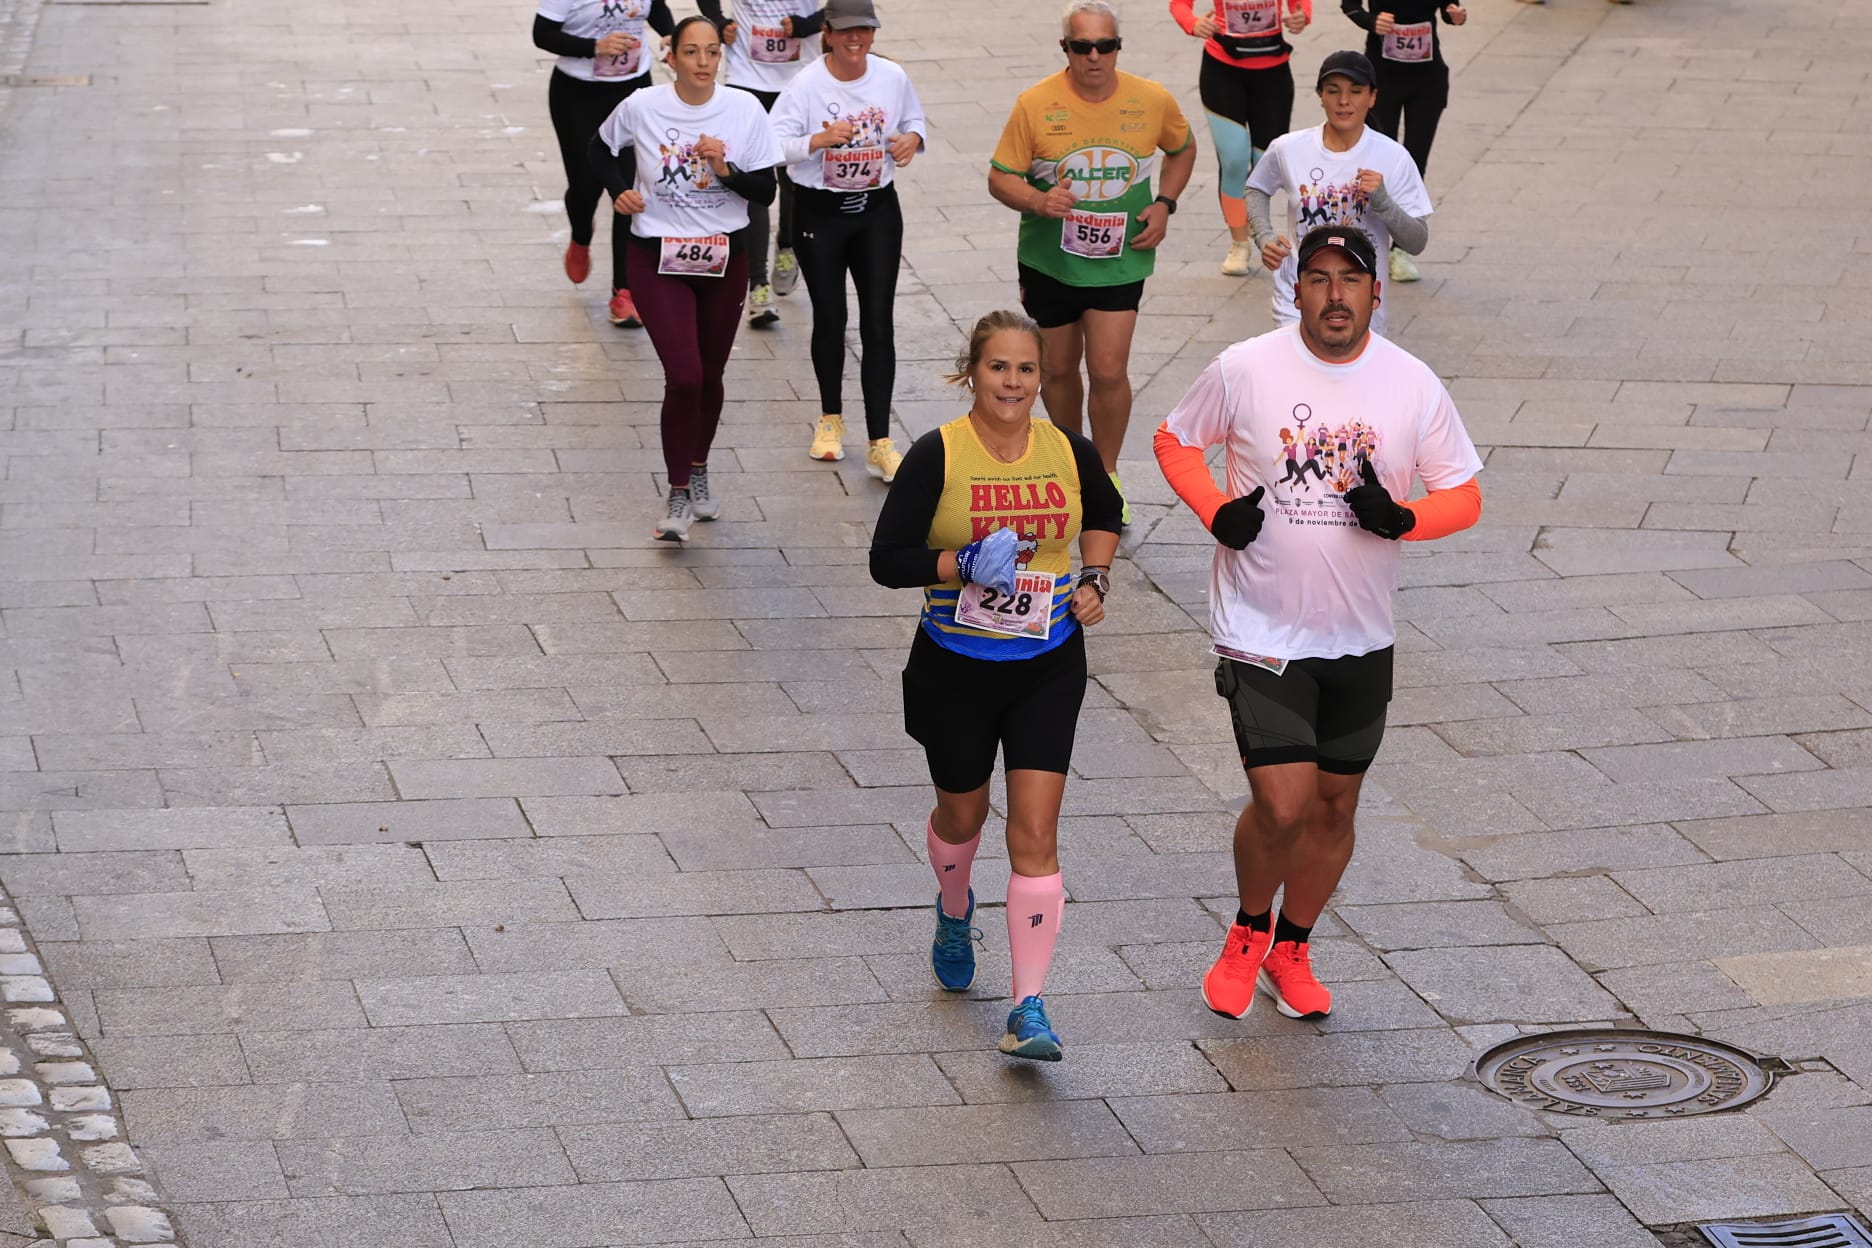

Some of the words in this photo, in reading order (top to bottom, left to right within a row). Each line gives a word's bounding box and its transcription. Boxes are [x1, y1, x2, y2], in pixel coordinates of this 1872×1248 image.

[1241, 11, 1262, 24] 94
[752, 24, 785, 38] bedu
[766, 39, 787, 52] 80
[1396, 36, 1423, 50] 541
[825, 150, 883, 162] bedunia
[836, 162, 871, 178] 374
[1062, 166, 1131, 182] ALCER
[1065, 214, 1125, 228] bedunia
[1077, 224, 1111, 244] 556
[676, 244, 713, 263] 484
[970, 481, 1067, 512] HELLO
[1275, 508, 1298, 516] PLAZA
[1301, 509, 1328, 517] MAYOR
[970, 513, 1069, 543] KITTY
[979, 587, 1032, 616] 228
[1500, 1055, 1602, 1116] SALAMANCA
